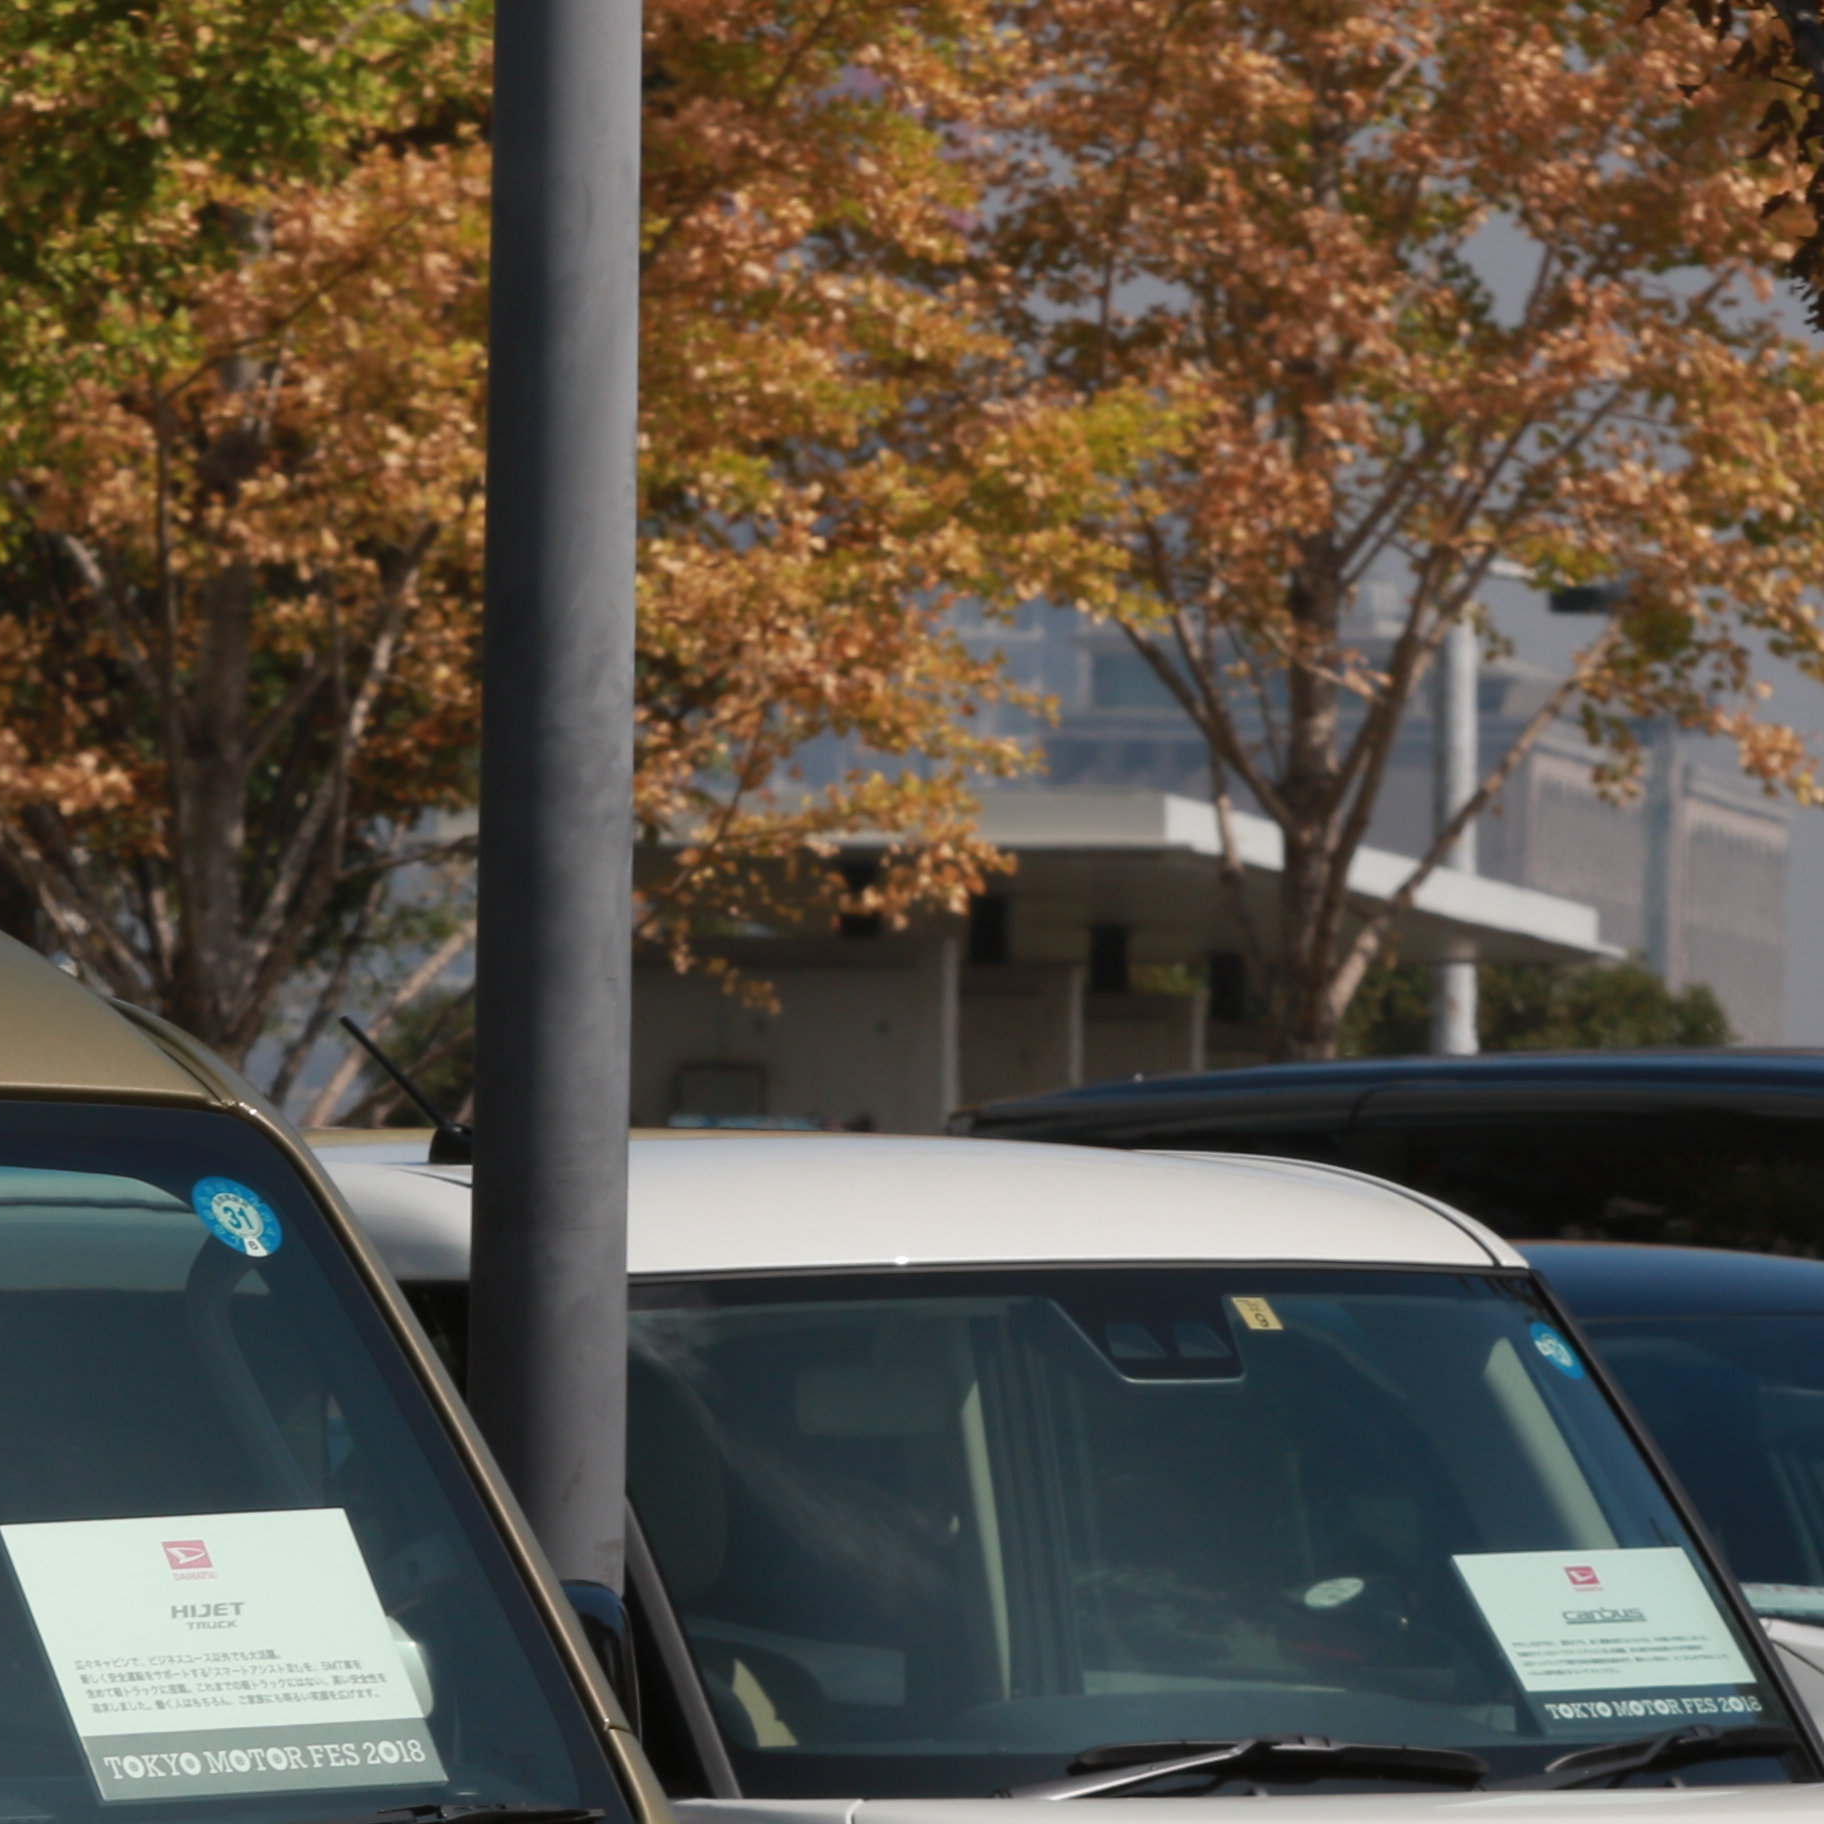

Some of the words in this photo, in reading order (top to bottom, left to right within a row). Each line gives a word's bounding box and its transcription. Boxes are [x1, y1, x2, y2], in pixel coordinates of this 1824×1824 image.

[223, 1206, 255, 1230] 31
[171, 1601, 245, 1619] HIJET
[186, 1620, 238, 1630] TRUCK
[1545, 1701, 1612, 1719] TOKYO
[1612, 1699, 1683, 1717] MOTOR
[1682, 1697, 1718, 1714] FES
[1718, 1696, 1762, 1712] 2018
[103, 1751, 201, 1780] TOKYO
[202, 1746, 307, 1774] MOTOR
[307, 1743, 360, 1767] FES
[363, 1739, 426, 1765] 2018
